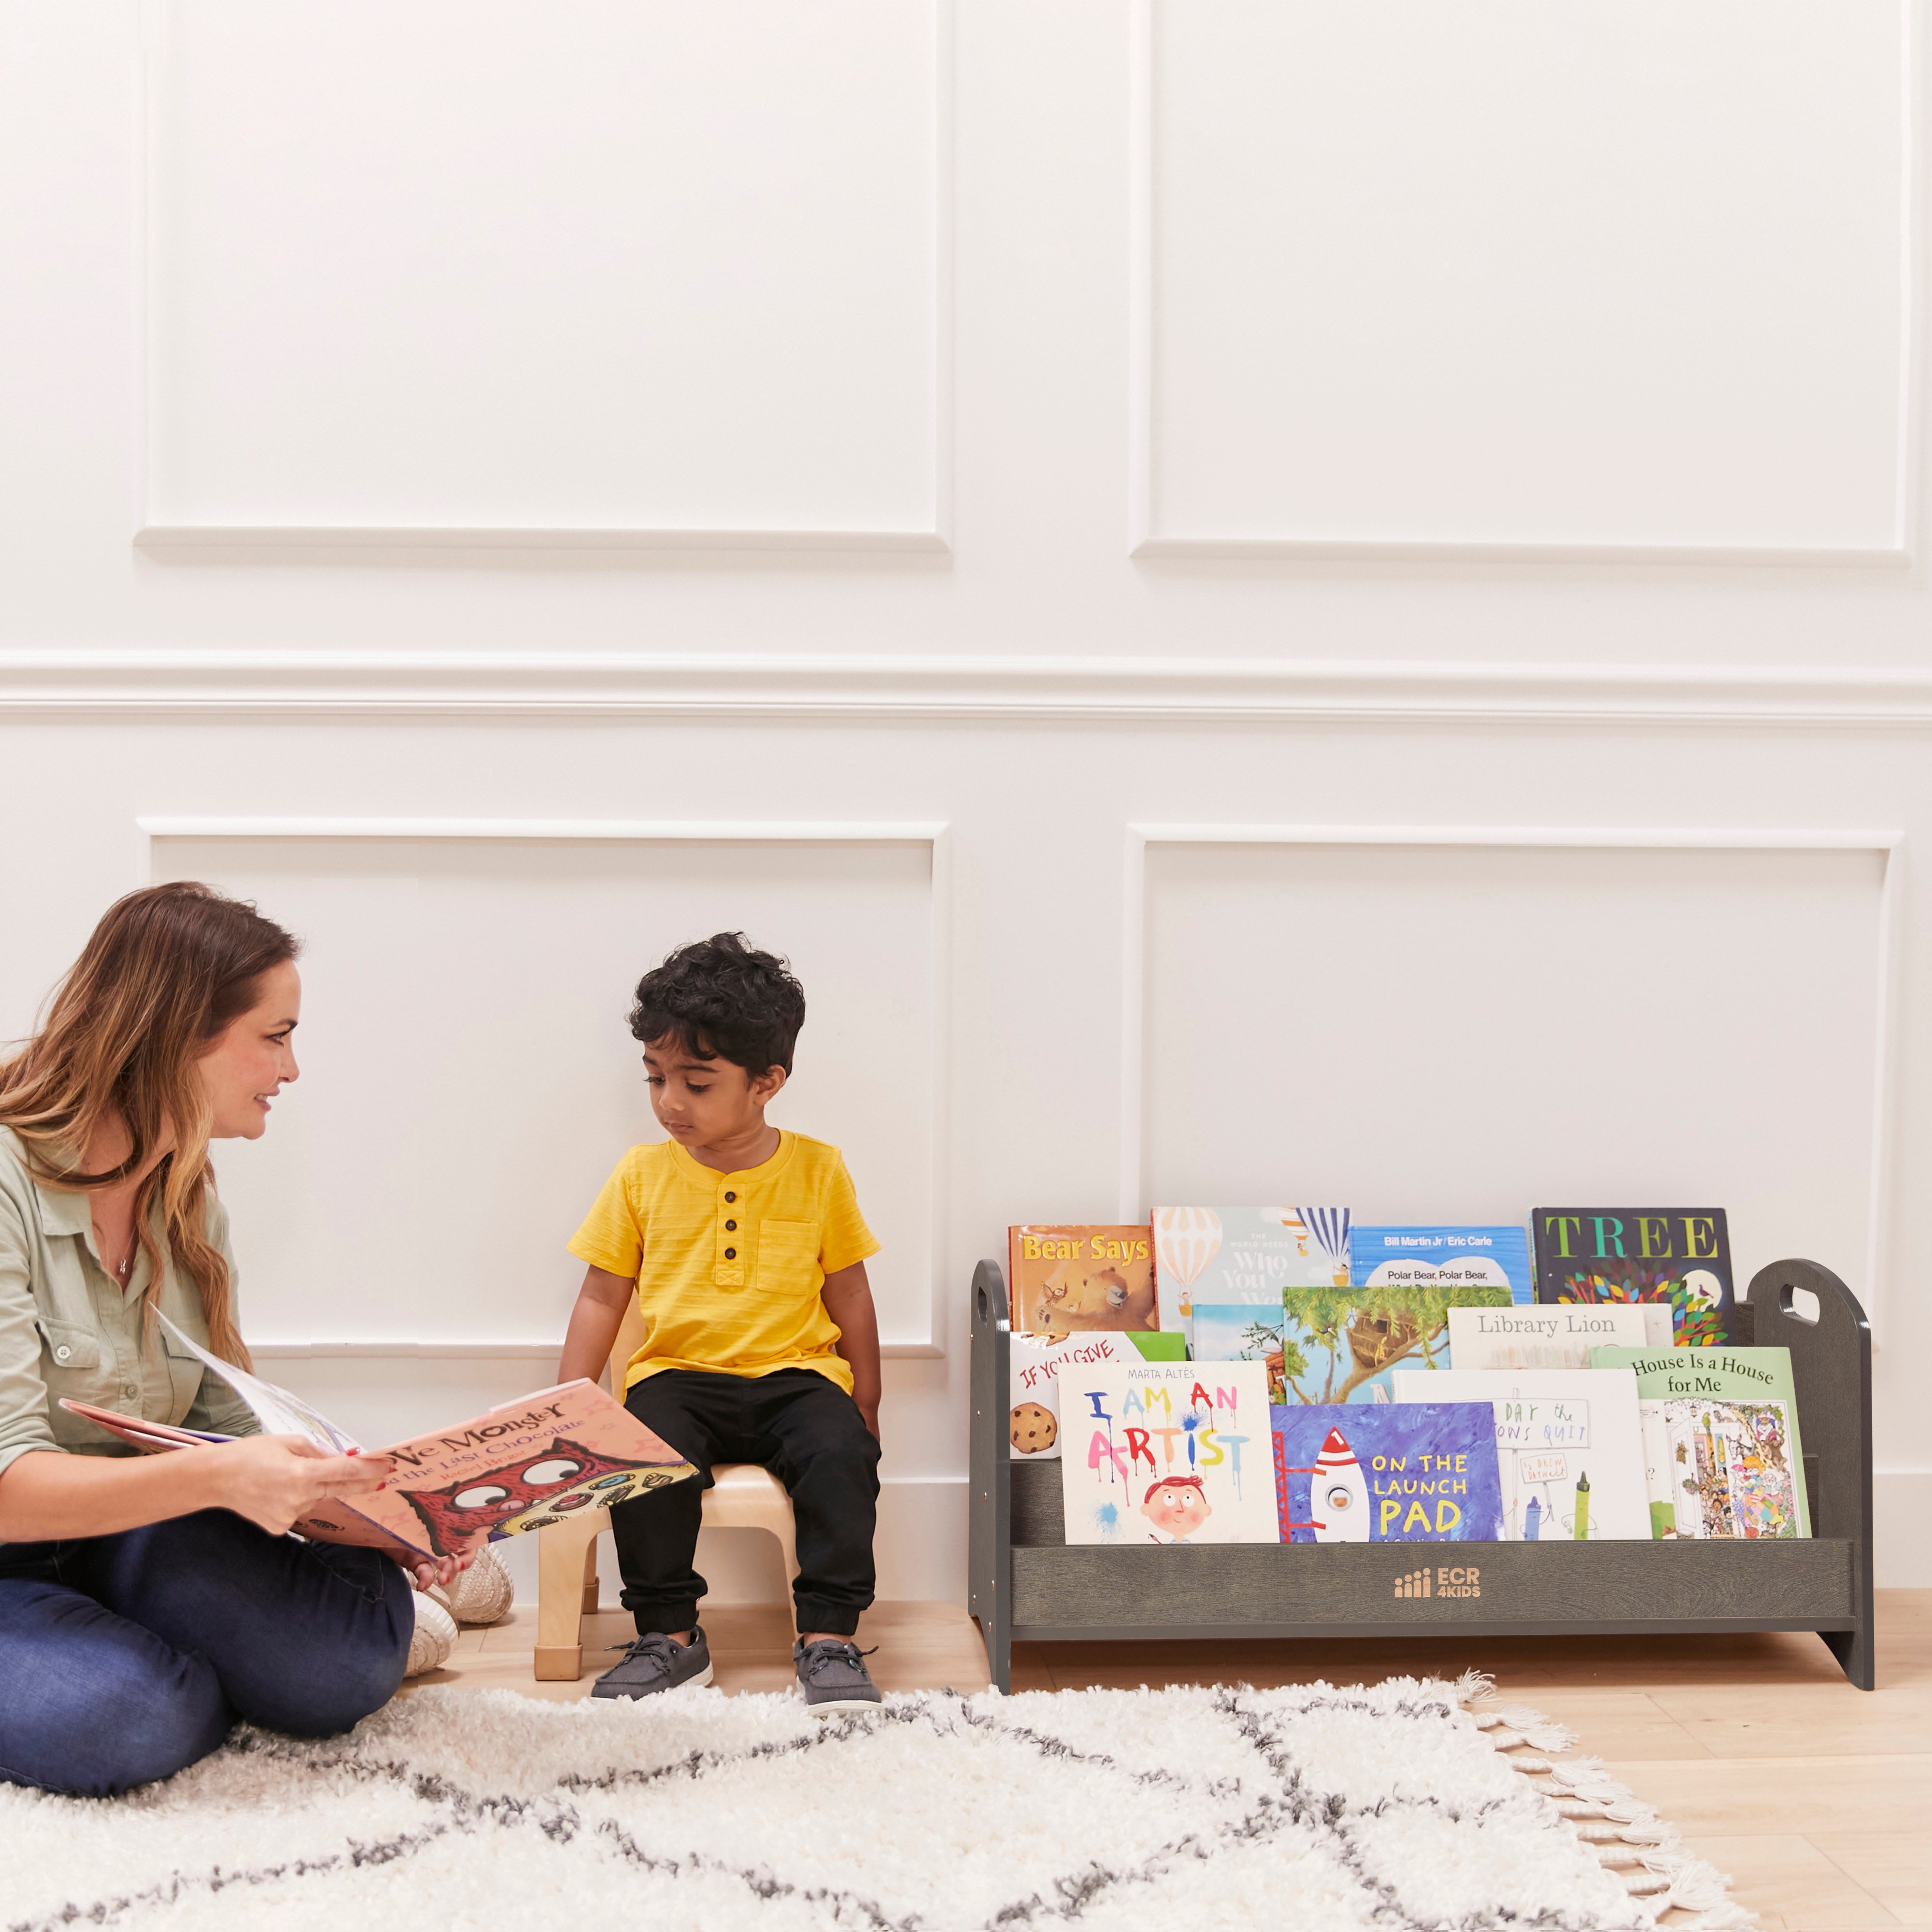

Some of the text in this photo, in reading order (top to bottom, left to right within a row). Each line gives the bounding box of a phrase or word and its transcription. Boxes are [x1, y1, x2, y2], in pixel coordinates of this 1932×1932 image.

[1384, 1236, 1400, 1246] Bill
[1401, 1236, 1431, 1246] Martin
[1467, 1236, 1492, 1246] Carle
[1546, 1216, 1719, 1258] TREE
[1023, 1234, 1150, 1267] Bear Says
[1233, 1251, 1288, 1279] Who
[1222, 1269, 1266, 1289] You
[1388, 1271, 1487, 1280] Polar Bear, Polar Bear,
[1477, 1315, 1616, 1338] Library Lion
[1020, 1365, 1037, 1389] IF
[1074, 1339, 1114, 1363] GIVE
[1128, 1367, 1195, 1379] MARTA ALTÉS
[1631, 1354, 1774, 1385] House Is a House
[1668, 1376, 1722, 1392] for Me
[1084, 1382, 1237, 1419] I AM AN
[1506, 1403, 1573, 1423] DAY the
[1331, 1430, 1344, 1446] 1
[1497, 1425, 1585, 1446] ONS QUIT
[1088, 1427, 1251, 1480] ARTIST
[1372, 1454, 1467, 1473] ON THE
[403, 1467, 434, 1480] the
[1374, 1479, 1466, 1495] LAUNCH
[1380, 1499, 1461, 1535] PAD
[1438, 1568, 1480, 1585] ECR
[1437, 1586, 1481, 1597] 4KIDS
